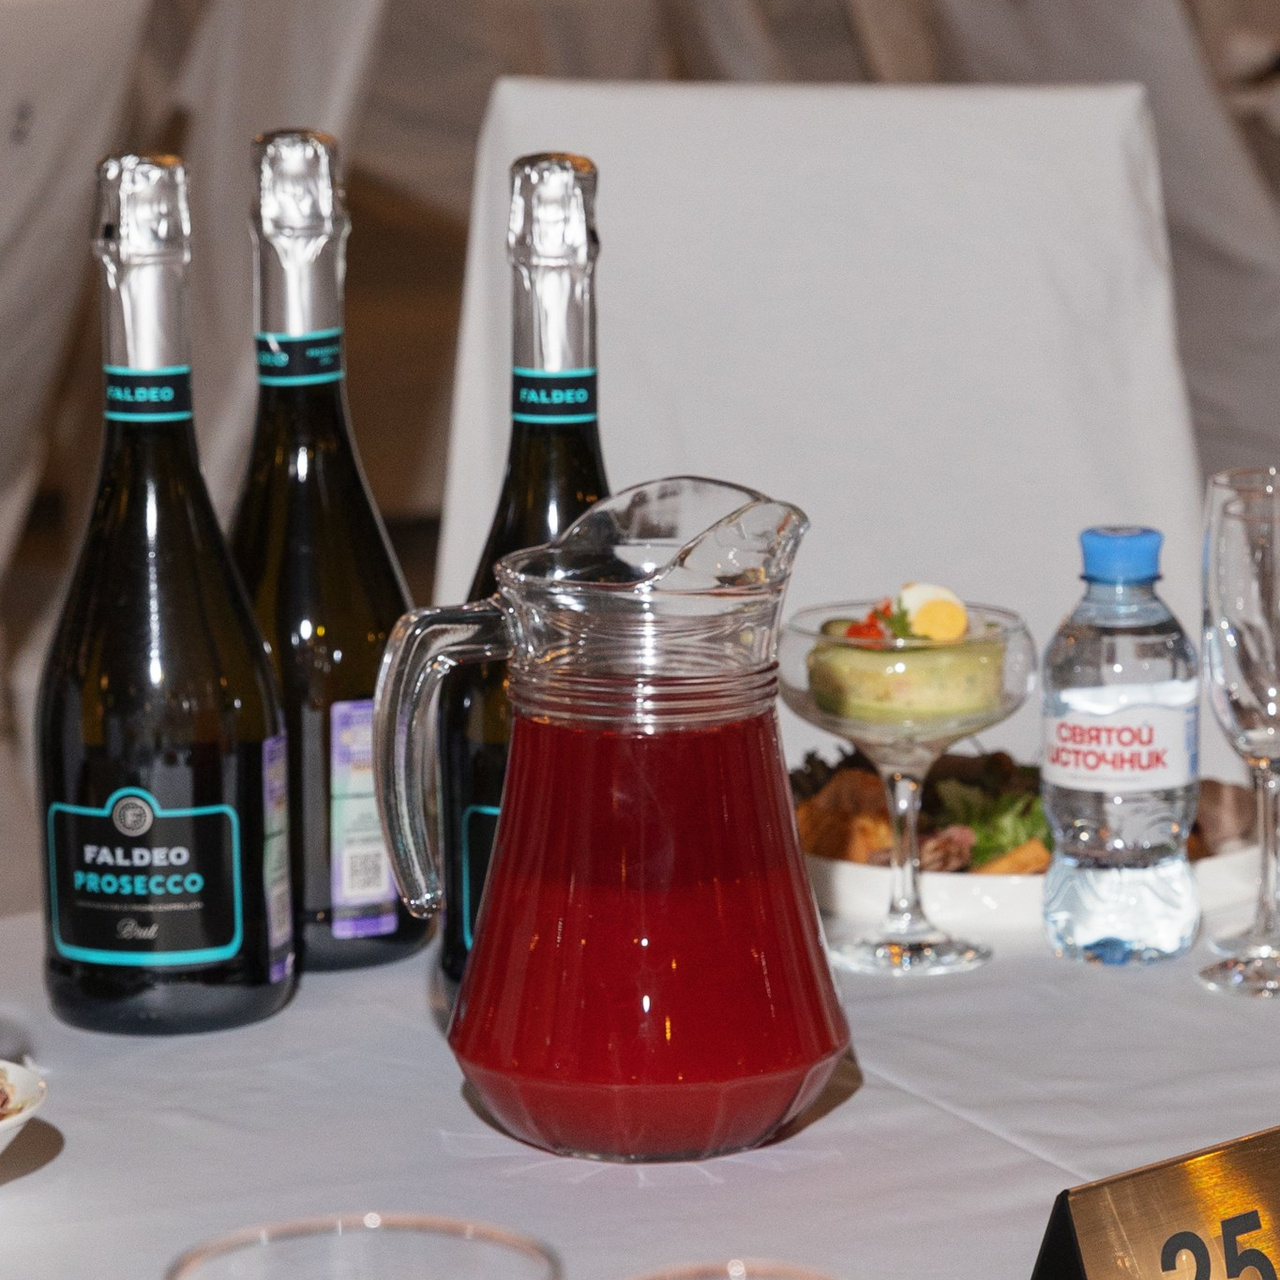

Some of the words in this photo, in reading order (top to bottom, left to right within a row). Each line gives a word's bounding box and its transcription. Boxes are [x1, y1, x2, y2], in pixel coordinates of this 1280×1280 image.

[519, 387, 588, 404] FALDEO
[83, 844, 190, 867] FALDEO
[73, 871, 205, 895] PROSECCO
